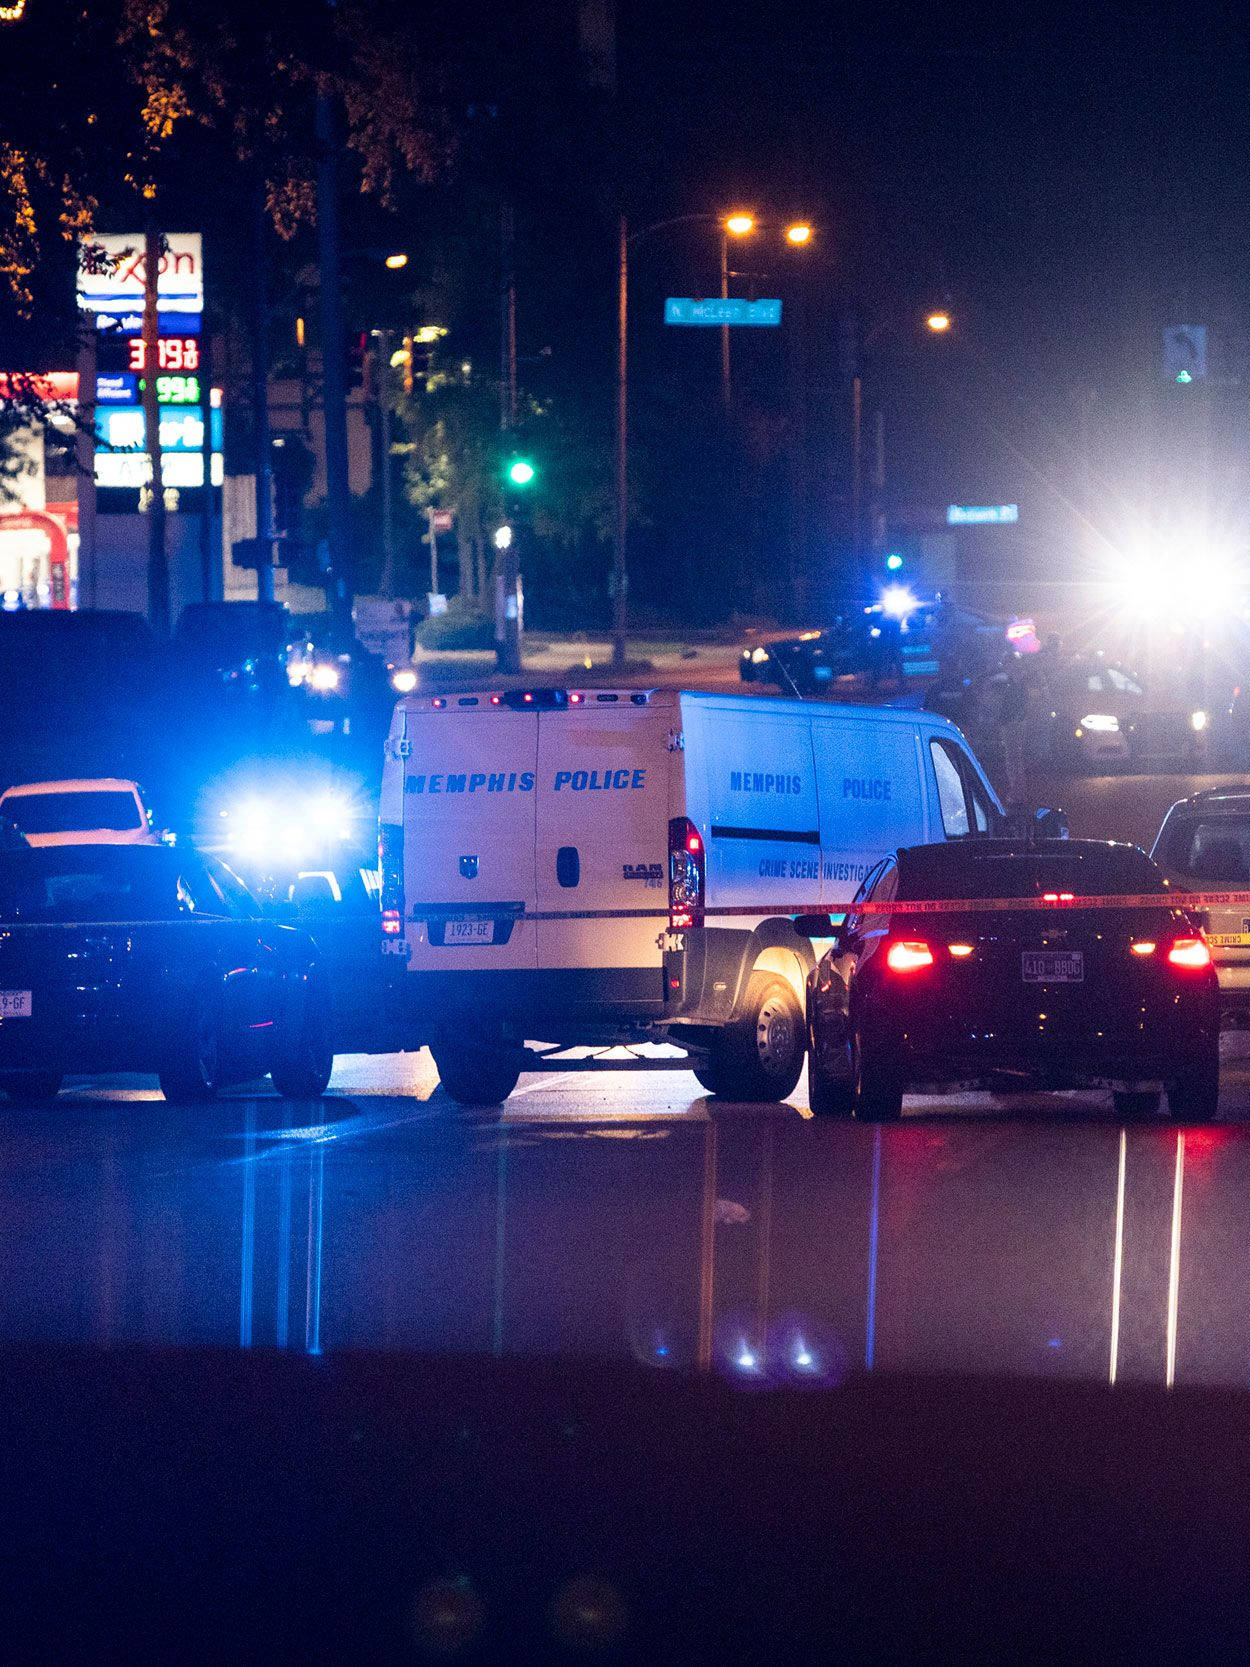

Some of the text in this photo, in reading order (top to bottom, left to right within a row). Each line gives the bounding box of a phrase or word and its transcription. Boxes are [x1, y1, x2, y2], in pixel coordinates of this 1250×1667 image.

[405, 769, 647, 794] MEMPHIS POLICE
[730, 771, 892, 800] MEMPHIS POLICE
[759, 859, 786, 878] CRIME
[790, 861, 819, 880] SCENE
